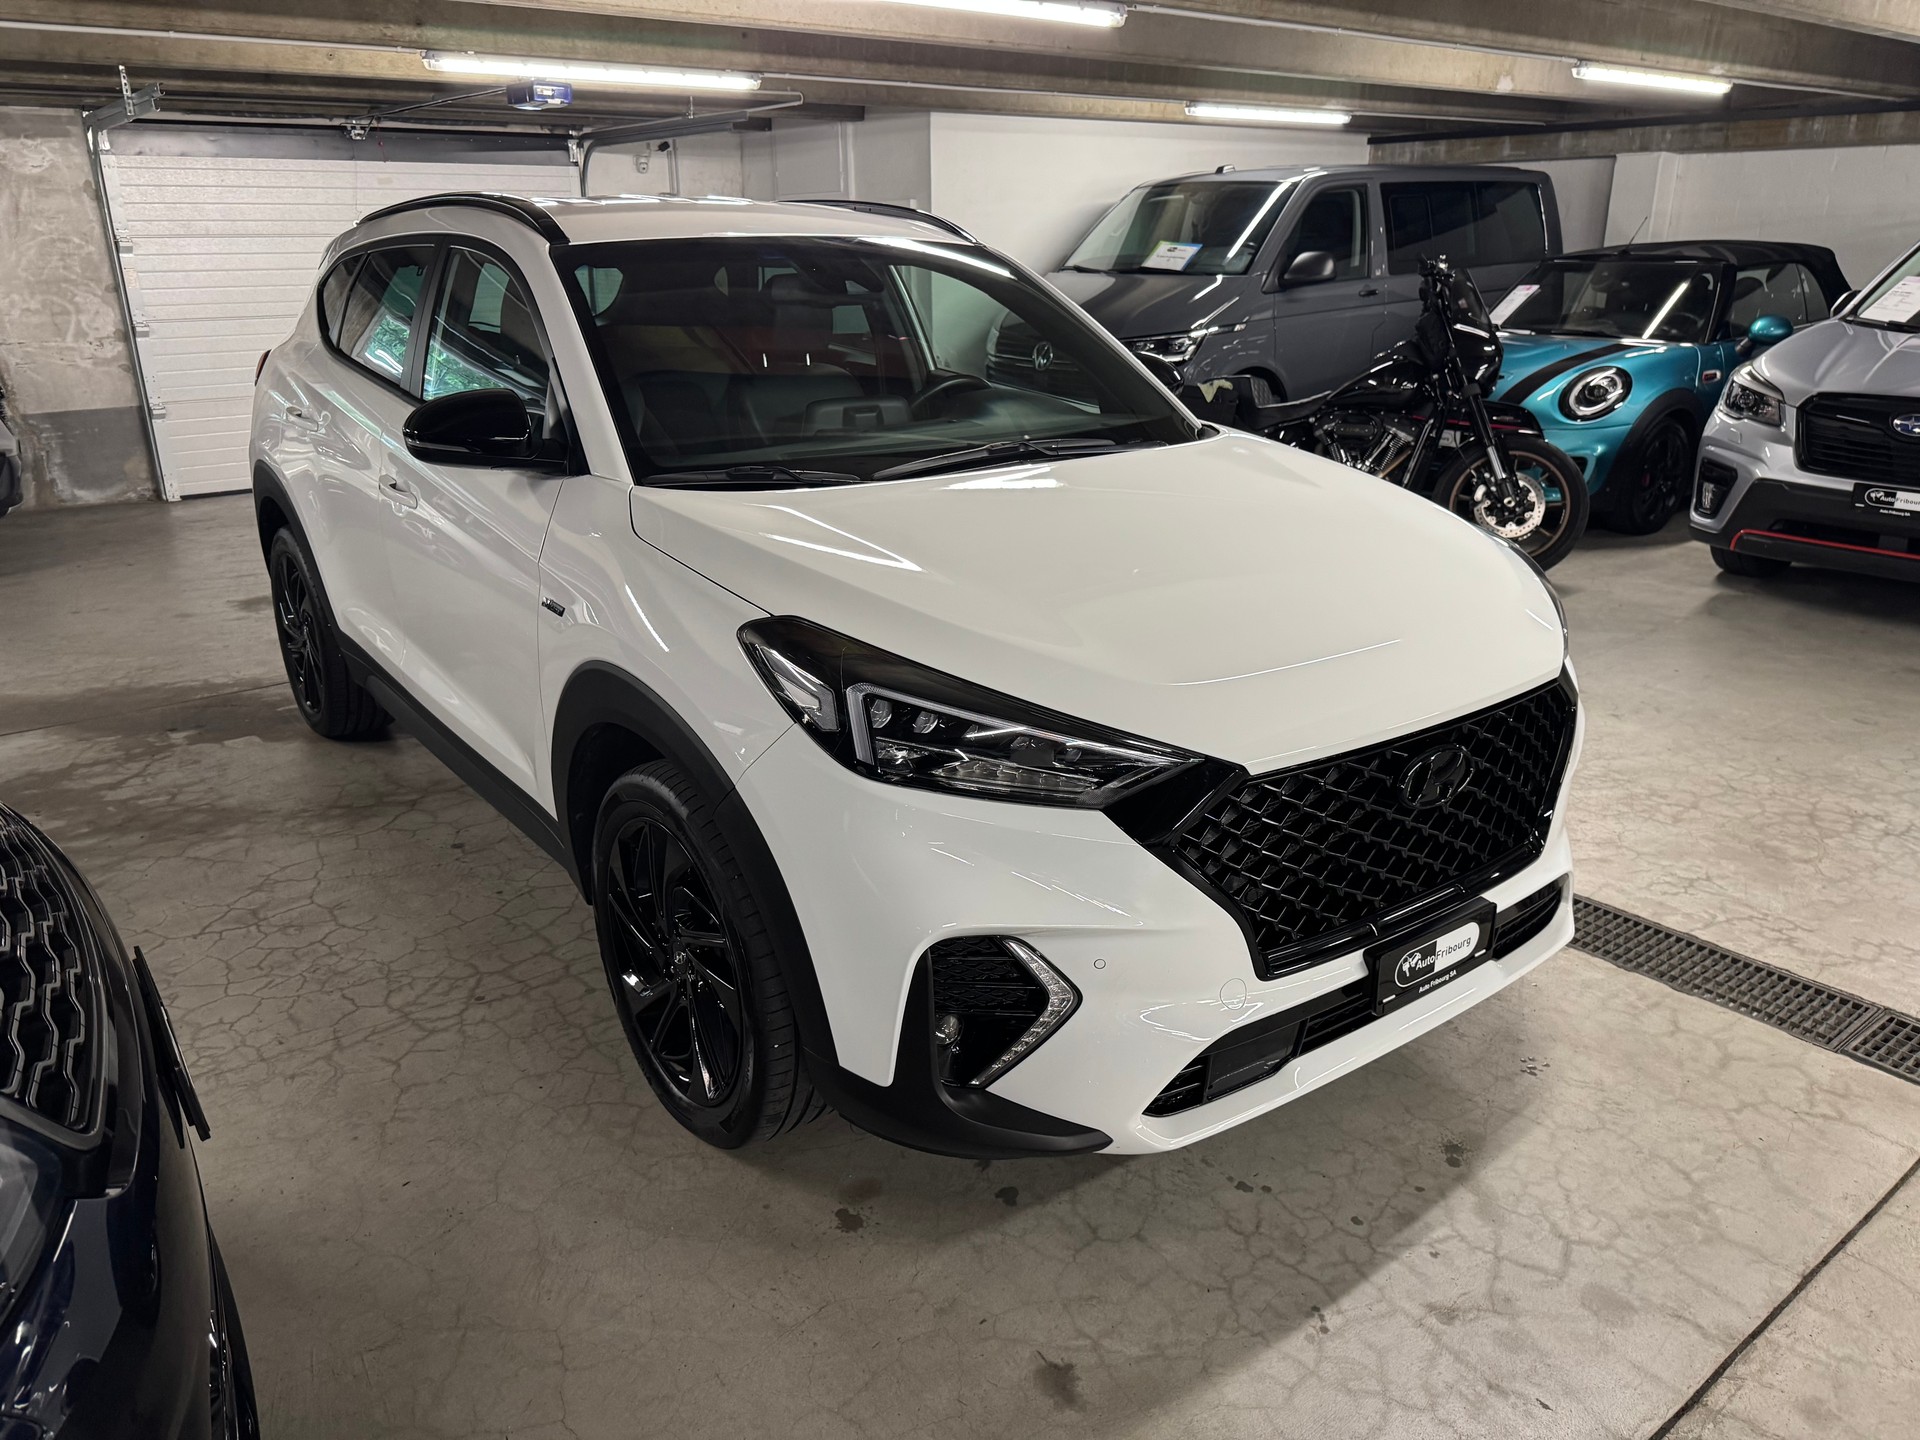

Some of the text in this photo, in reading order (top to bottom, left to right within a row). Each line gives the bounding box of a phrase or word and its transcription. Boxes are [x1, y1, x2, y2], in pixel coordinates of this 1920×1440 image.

[1419, 969, 1457, 993] Auto Fribourg SA
